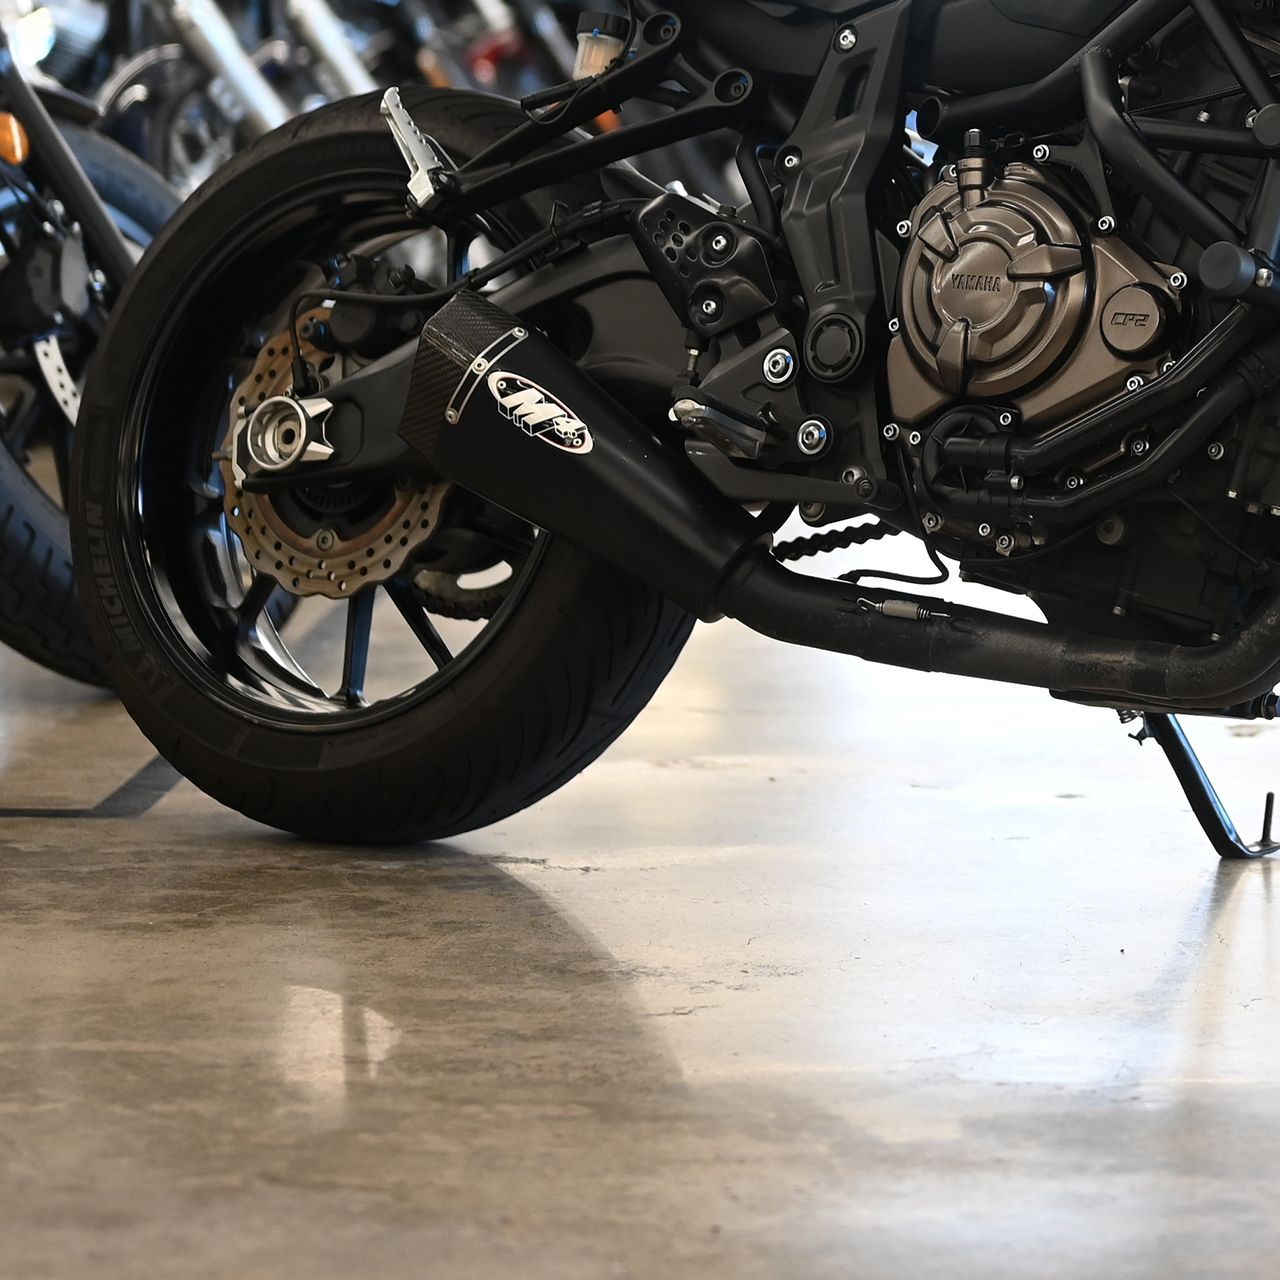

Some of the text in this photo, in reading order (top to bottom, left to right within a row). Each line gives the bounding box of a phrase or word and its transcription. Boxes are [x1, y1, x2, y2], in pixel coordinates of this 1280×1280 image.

[951, 273, 1001, 293] YAMAHA
[1110, 311, 1150, 327] CP2
[497, 387, 588, 439] M4
[84, 500, 142, 653] MICHELIN
